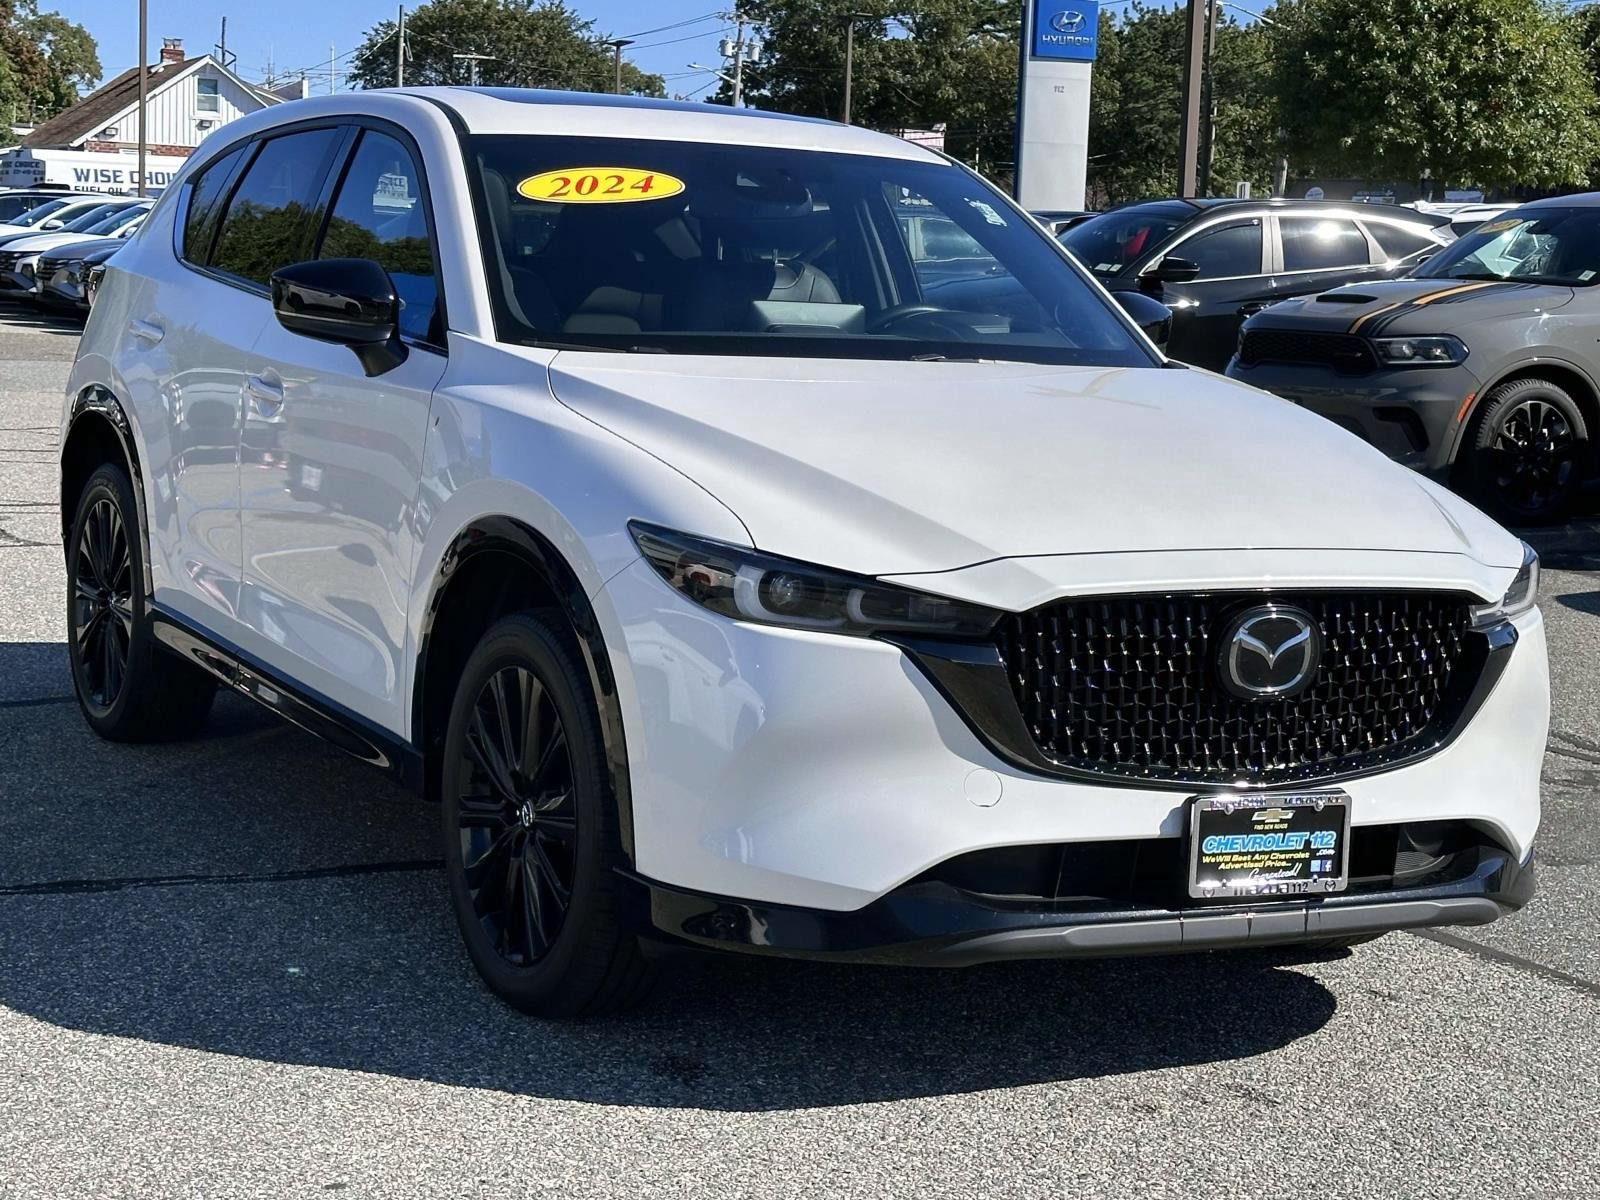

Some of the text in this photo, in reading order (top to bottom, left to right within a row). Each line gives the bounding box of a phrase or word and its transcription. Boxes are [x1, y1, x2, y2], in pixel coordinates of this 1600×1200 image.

[1042, 34, 1093, 46] HYUNDAI
[1054, 85, 1065, 93] 112
[73, 168, 124, 184] WISE
[547, 175, 654, 198] 2024
[1202, 831, 1336, 854] CHEVROLET 112
[1252, 853, 1269, 861] Any
[1270, 852, 1310, 860] Chevrolet
[1218, 862, 1264, 870] Advertised
[1291, 882, 1309, 893] 112
